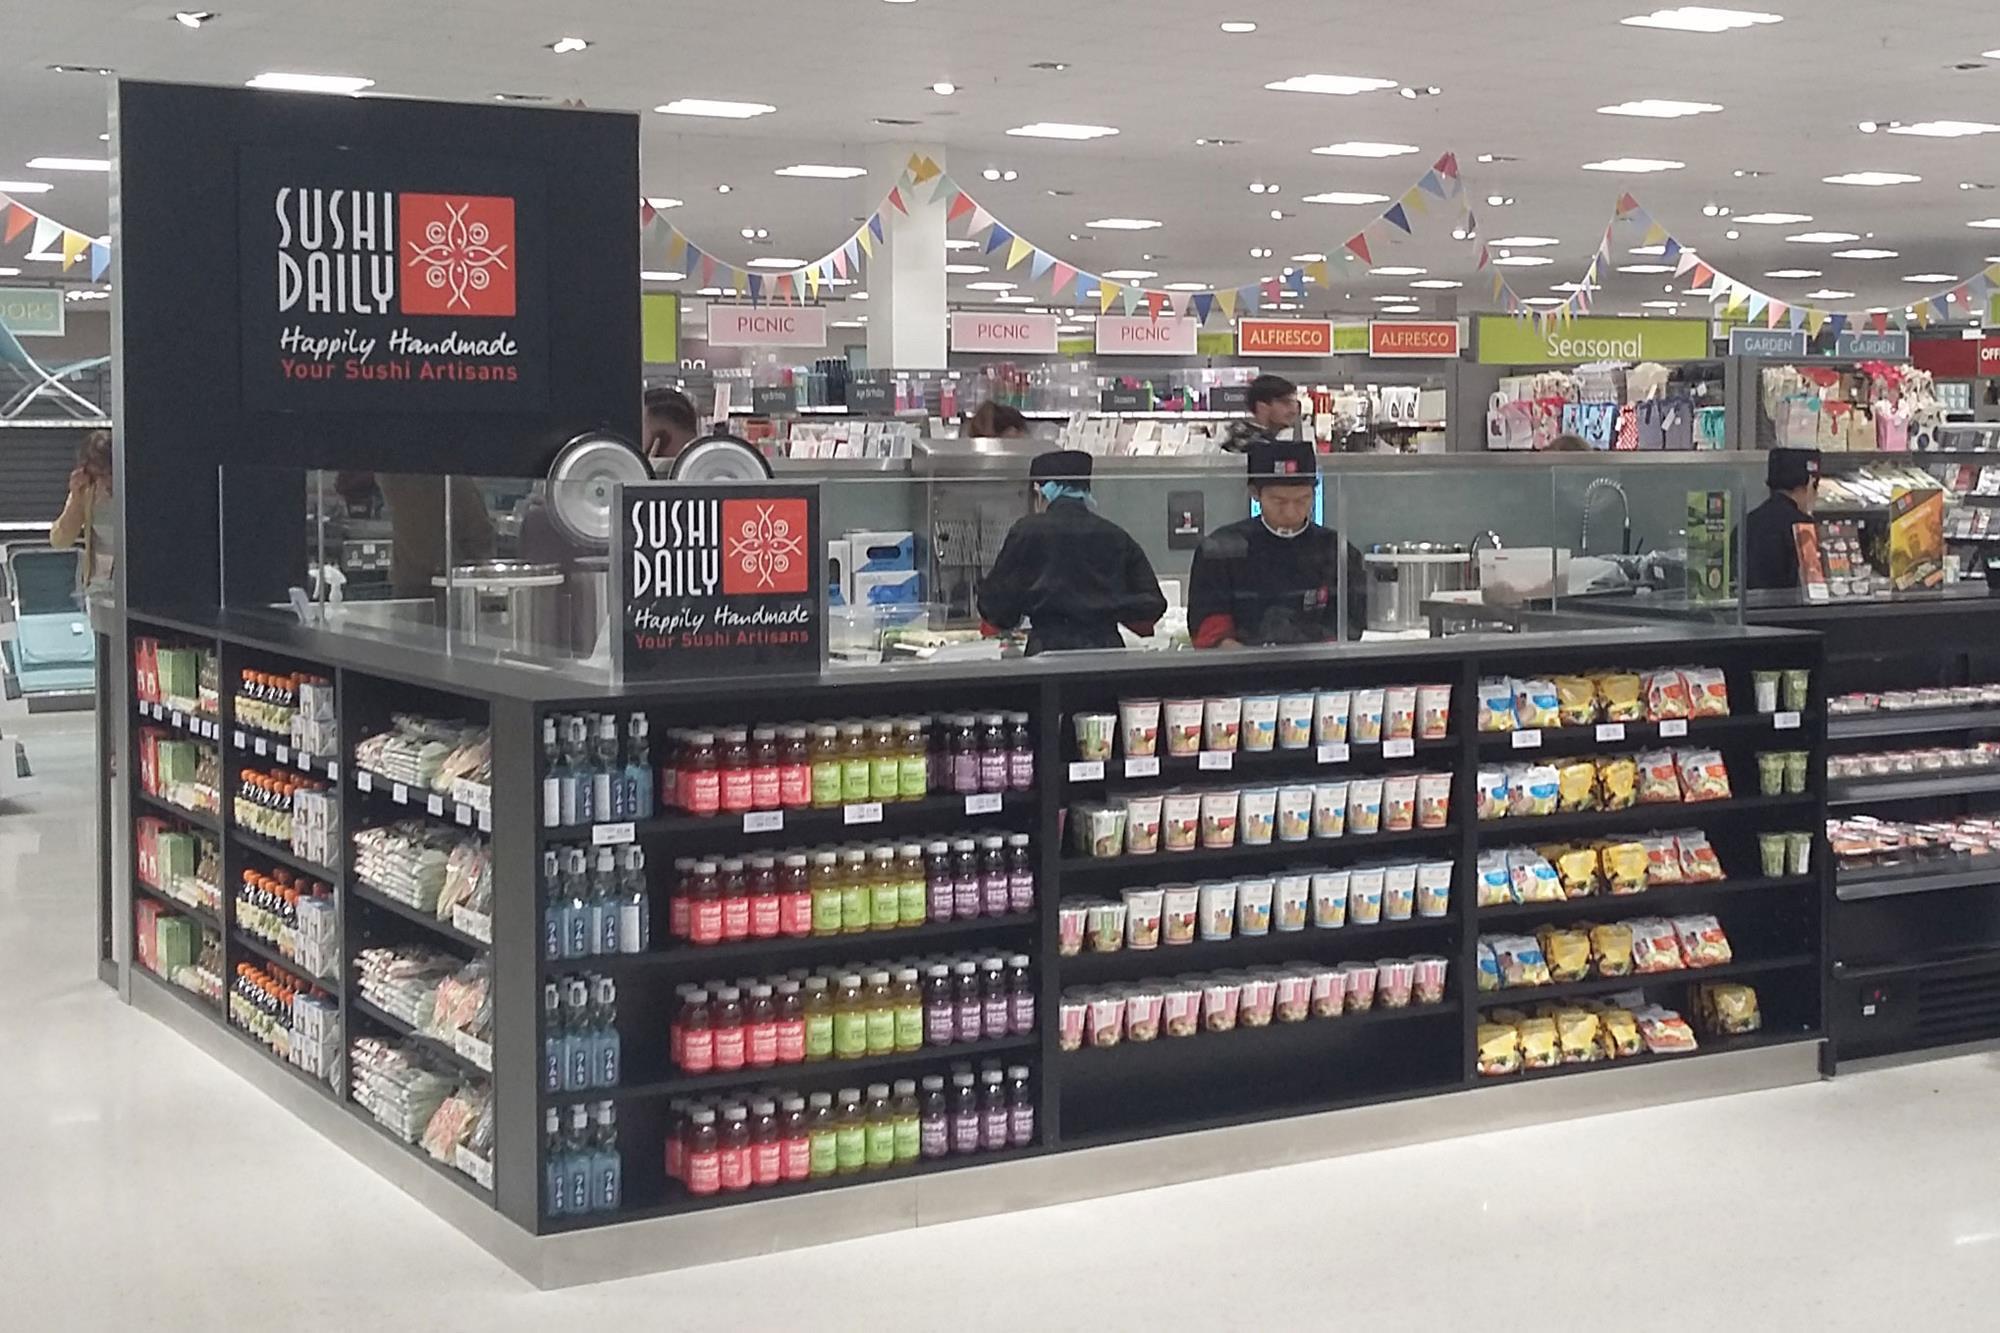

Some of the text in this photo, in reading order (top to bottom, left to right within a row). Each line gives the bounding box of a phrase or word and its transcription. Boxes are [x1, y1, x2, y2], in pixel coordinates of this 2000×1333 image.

[276, 187, 394, 251] SUSHI
[278, 250, 395, 315] DAILY
[0, 303, 54, 321] ORS
[737, 316, 795, 333] PICNIC
[977, 323, 1031, 340] PICNIC
[1121, 325, 1171, 341] PICNIC
[280, 325, 518, 364] Happily Handmade
[1250, 329, 1324, 346] ALFRESCO
[1380, 331, 1450, 347] ALFRESCO
[1546, 333, 1642, 359] Seasonal
[1744, 337, 1793, 352] GARDEN
[1850, 340, 1897, 354] GARDEN
[281, 359, 518, 381] Your Sushi Artisans
[632, 499, 718, 549] SUSHI
[633, 549, 719, 598] DAILY
[634, 604, 810, 635] Happily Handmade
[635, 629, 809, 649] Your Sushi Artisans
